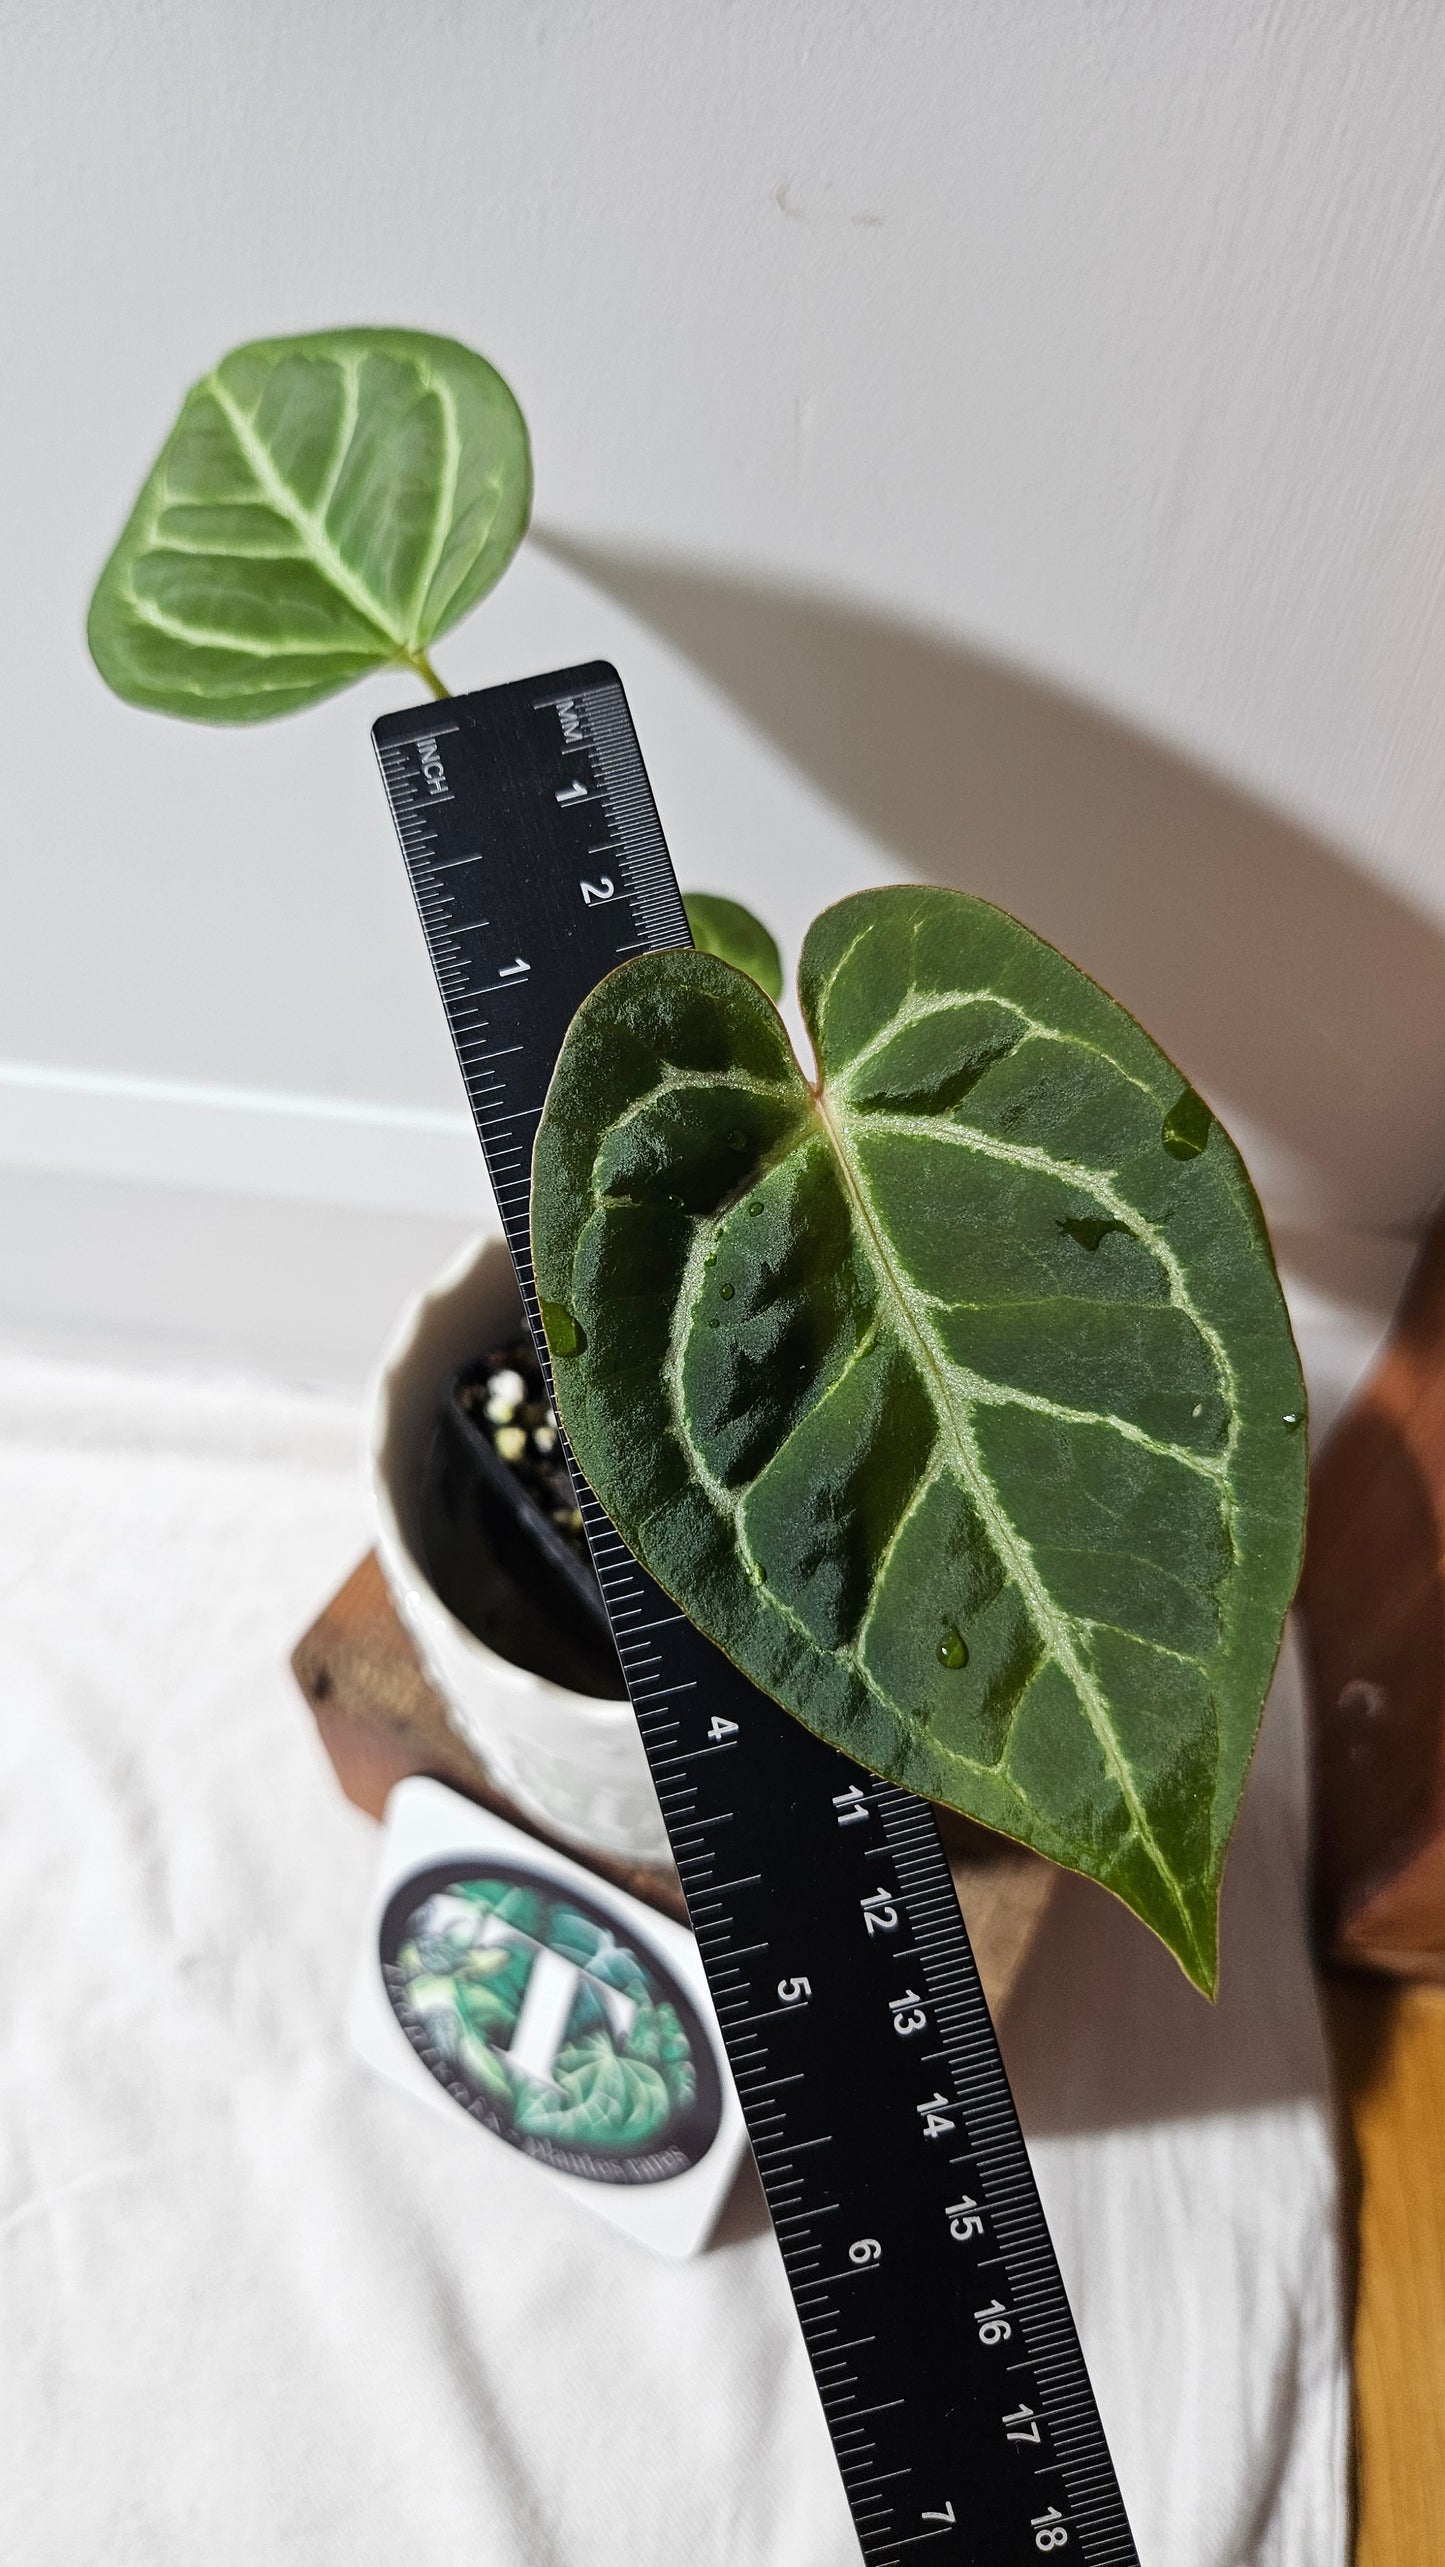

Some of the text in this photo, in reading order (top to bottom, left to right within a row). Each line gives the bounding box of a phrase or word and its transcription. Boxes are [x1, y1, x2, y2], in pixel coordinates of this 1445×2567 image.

[556, 700, 583, 744] MM
[416, 738, 448, 795] INCH
[555, 780, 588, 802] 1
[580, 876, 615, 904] 2
[499, 958, 531, 977] 1
[708, 1716, 739, 1740] 4
[832, 1785, 869, 1826] 11
[860, 1887, 898, 1937] 12
[777, 1976, 812, 2001] 5
[889, 1989, 927, 2035] 13
[917, 2092, 955, 2138] 14
[945, 2195, 984, 2241] 15
[848, 2238, 882, 2263] 6
[974, 2299, 1011, 2345] 16
[1002, 2403, 1041, 2443] 17
[922, 2502, 956, 2522] 7
[1030, 2506, 1068, 2551] 18
